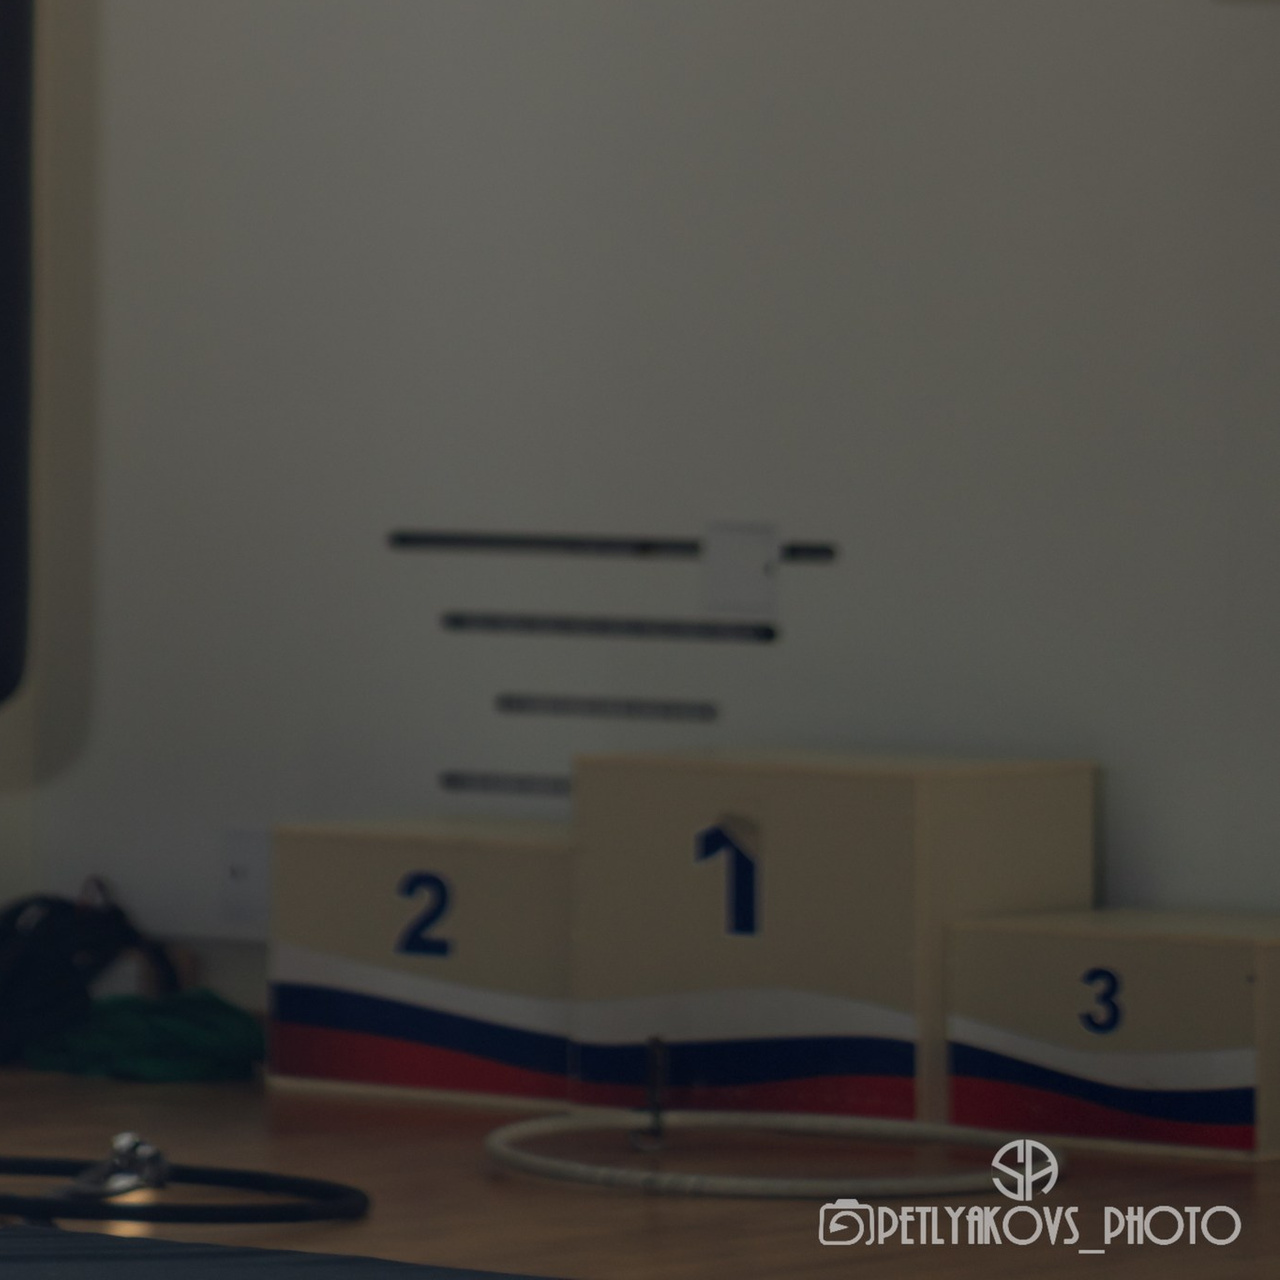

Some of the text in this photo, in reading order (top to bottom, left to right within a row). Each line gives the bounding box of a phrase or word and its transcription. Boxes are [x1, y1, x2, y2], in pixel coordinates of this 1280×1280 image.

[395, 870, 451, 956] 2
[694, 824, 760, 936] 1
[1079, 967, 1122, 1034] 3
